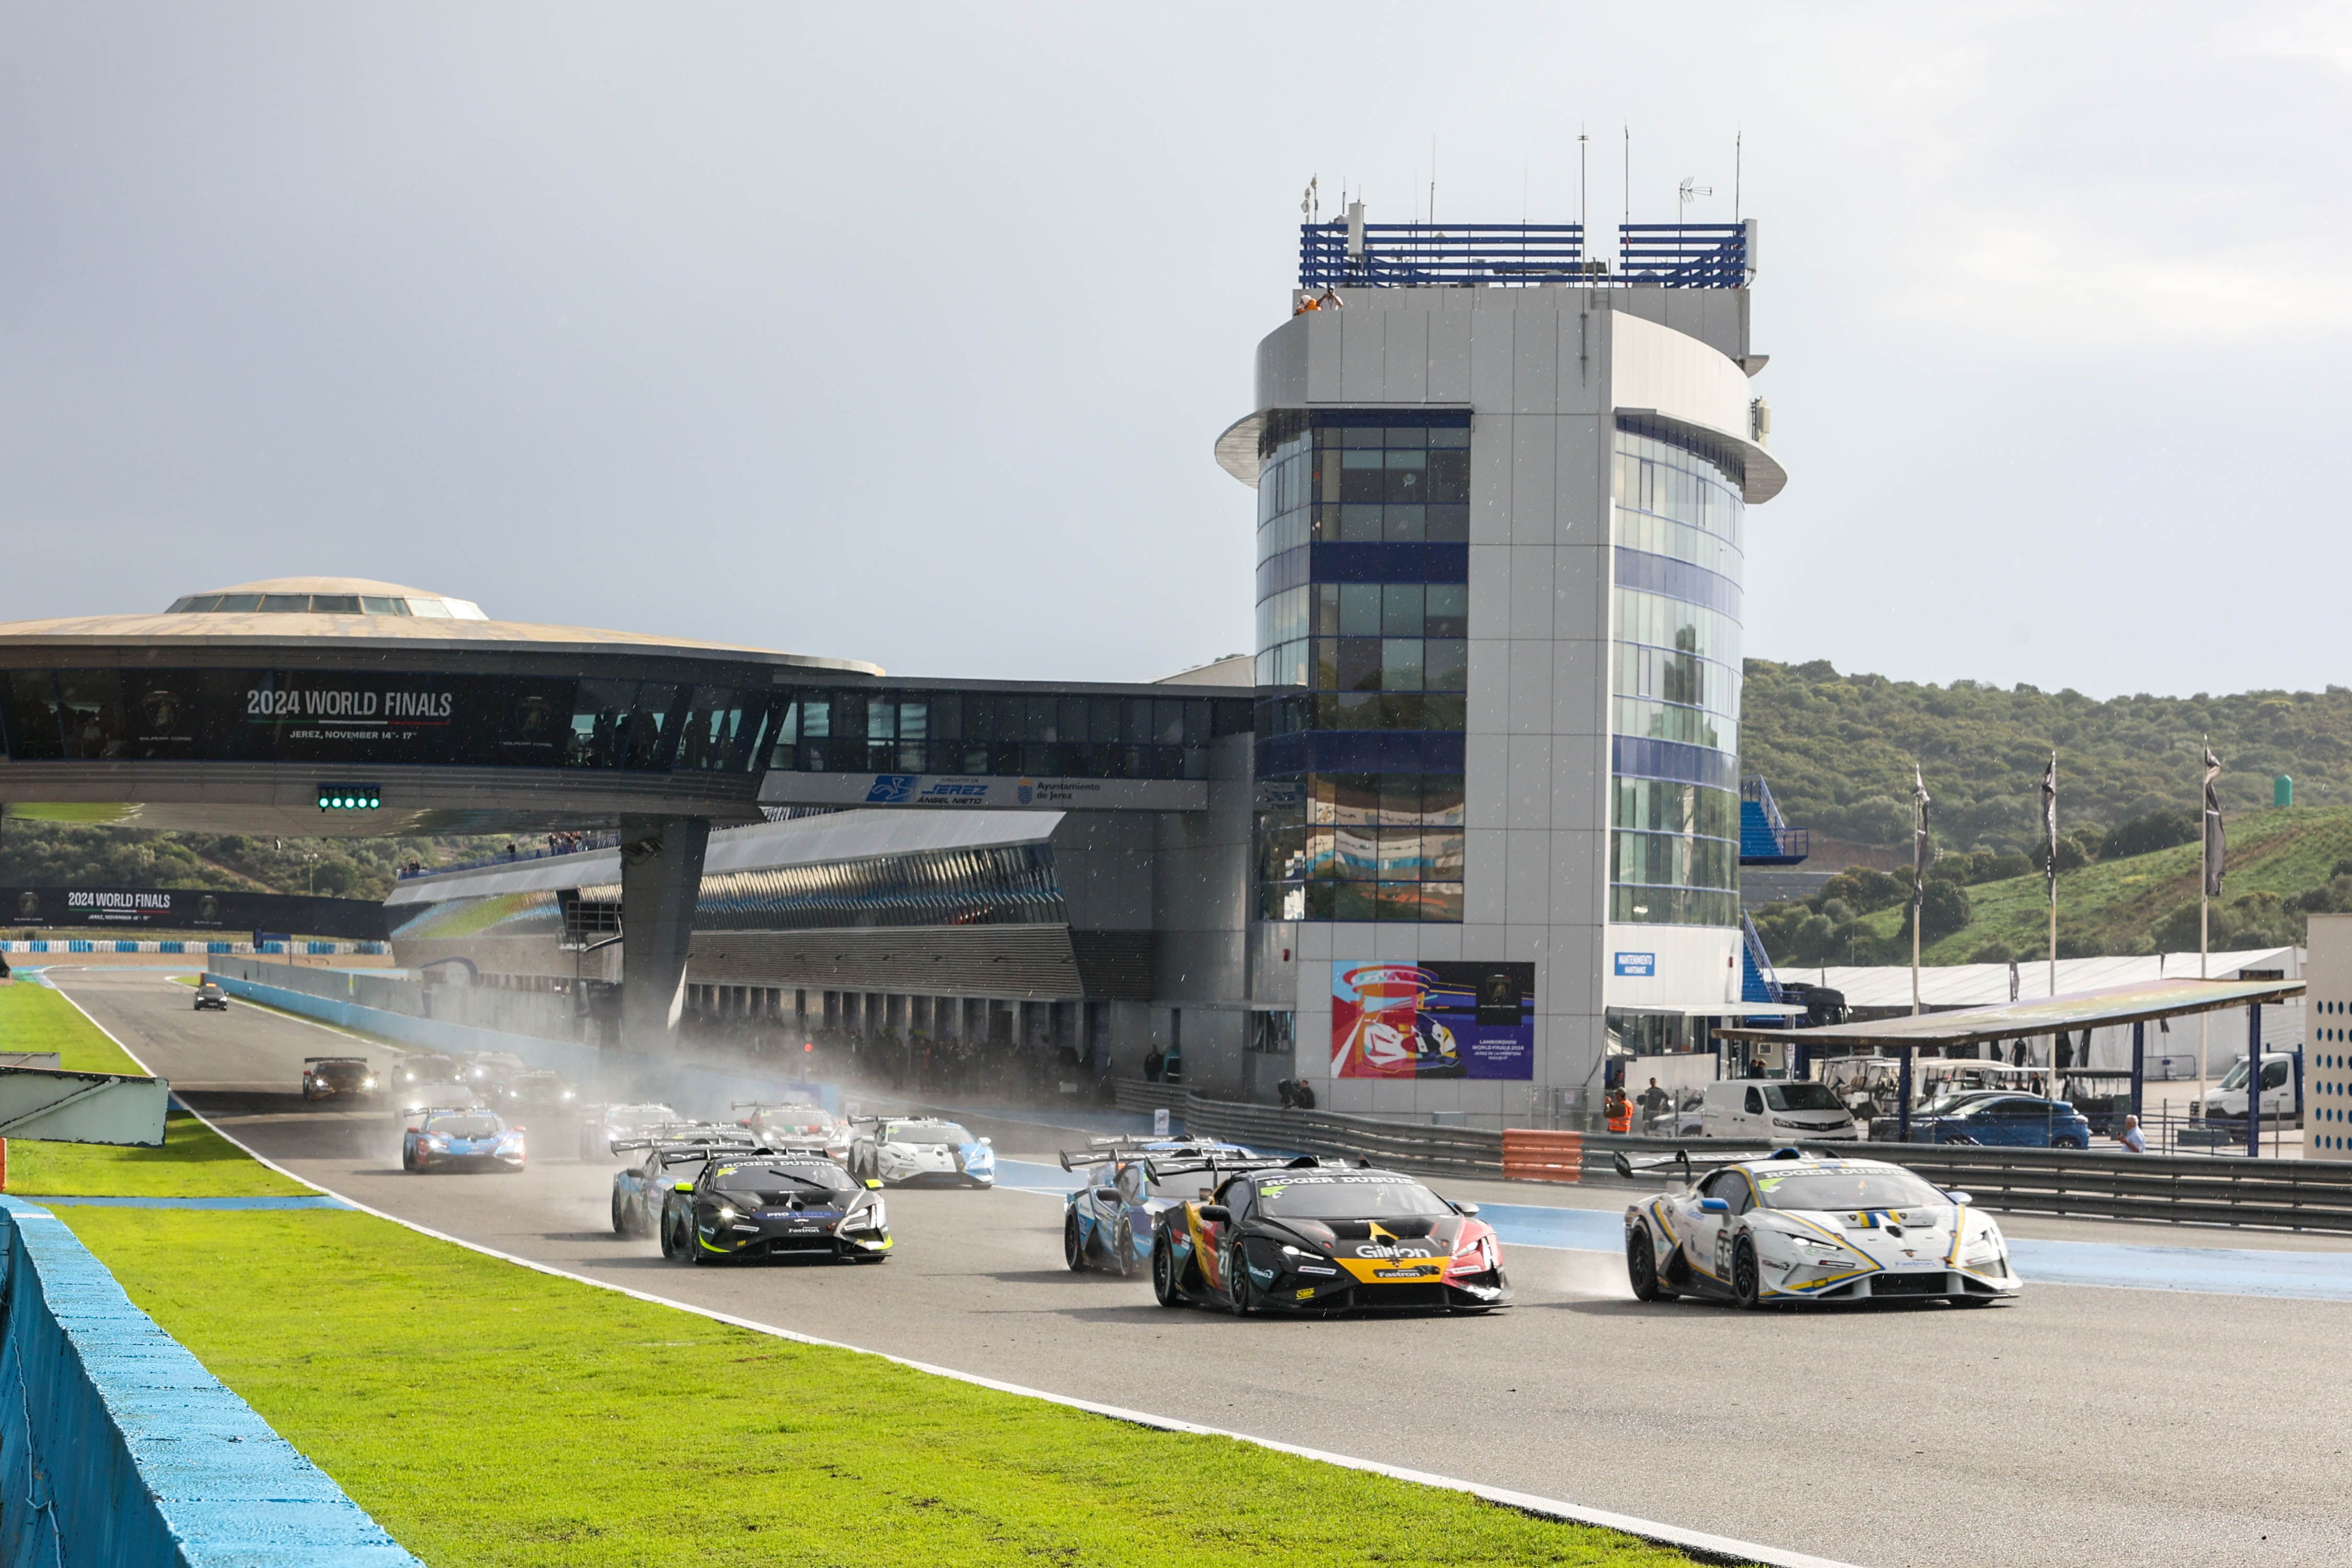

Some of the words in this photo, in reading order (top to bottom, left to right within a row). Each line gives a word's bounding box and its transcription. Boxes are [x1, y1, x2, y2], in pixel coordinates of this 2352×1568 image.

[247, 690, 300, 714] 2024
[305, 690, 377, 716] WORLD
[385, 692, 453, 717] FINALS
[290, 731, 324, 739] JEREZ,
[325, 731, 378, 739] NOVEMBER
[921, 785, 988, 795] JEREZ
[1037, 782, 1100, 791] Ayuntamiento
[916, 795, 949, 804] ÁNGEL
[1050, 792, 1073, 800] Jerez
[68, 892, 94, 906] 2024
[96, 892, 133, 907] WORLD
[135, 893, 170, 908] FINALS
[1765, 1169, 1835, 1179] ROGER
[1265, 1177, 1335, 1186] ROGER
[1341, 1175, 1416, 1184] DUBUIS
[1716, 1238, 1730, 1268] 66
[1296, 1290, 1315, 1298] OMP
